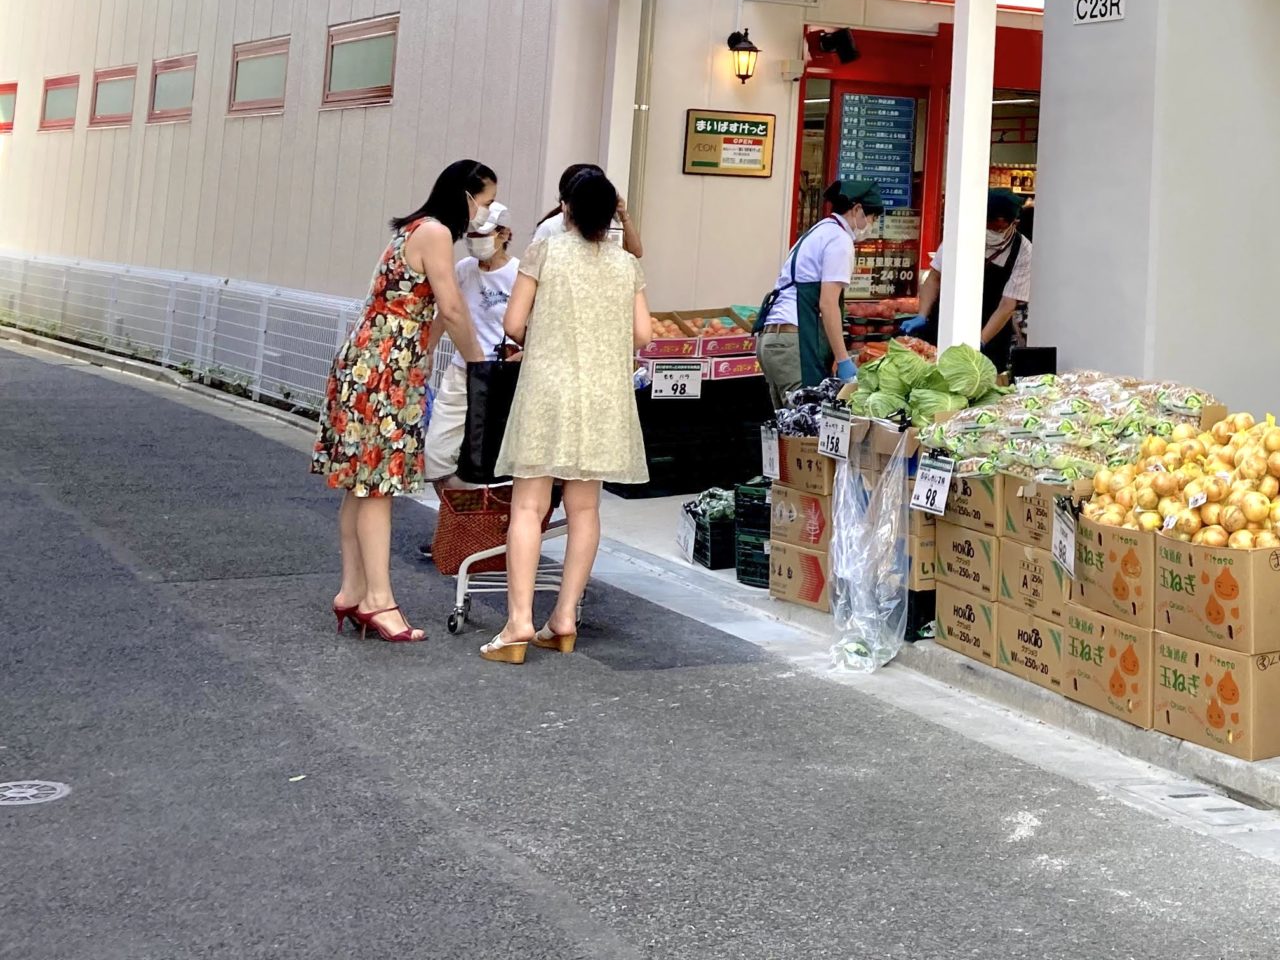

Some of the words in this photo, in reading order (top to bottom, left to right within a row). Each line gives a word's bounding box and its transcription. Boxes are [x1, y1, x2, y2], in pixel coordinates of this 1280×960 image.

[695, 120, 767, 135] まいばすけっと
[671, 383, 687, 395] 98
[826, 434, 840, 453] 158
[925, 488, 938, 507] 98
[1026, 508, 1033, 523] A
[1022, 574, 1028, 589] A
[1159, 566, 1197, 596] 玉ねぎ
[1068, 635, 1105, 667] 玉ねぎ
[1159, 665, 1200, 697] 玉ねぎ
